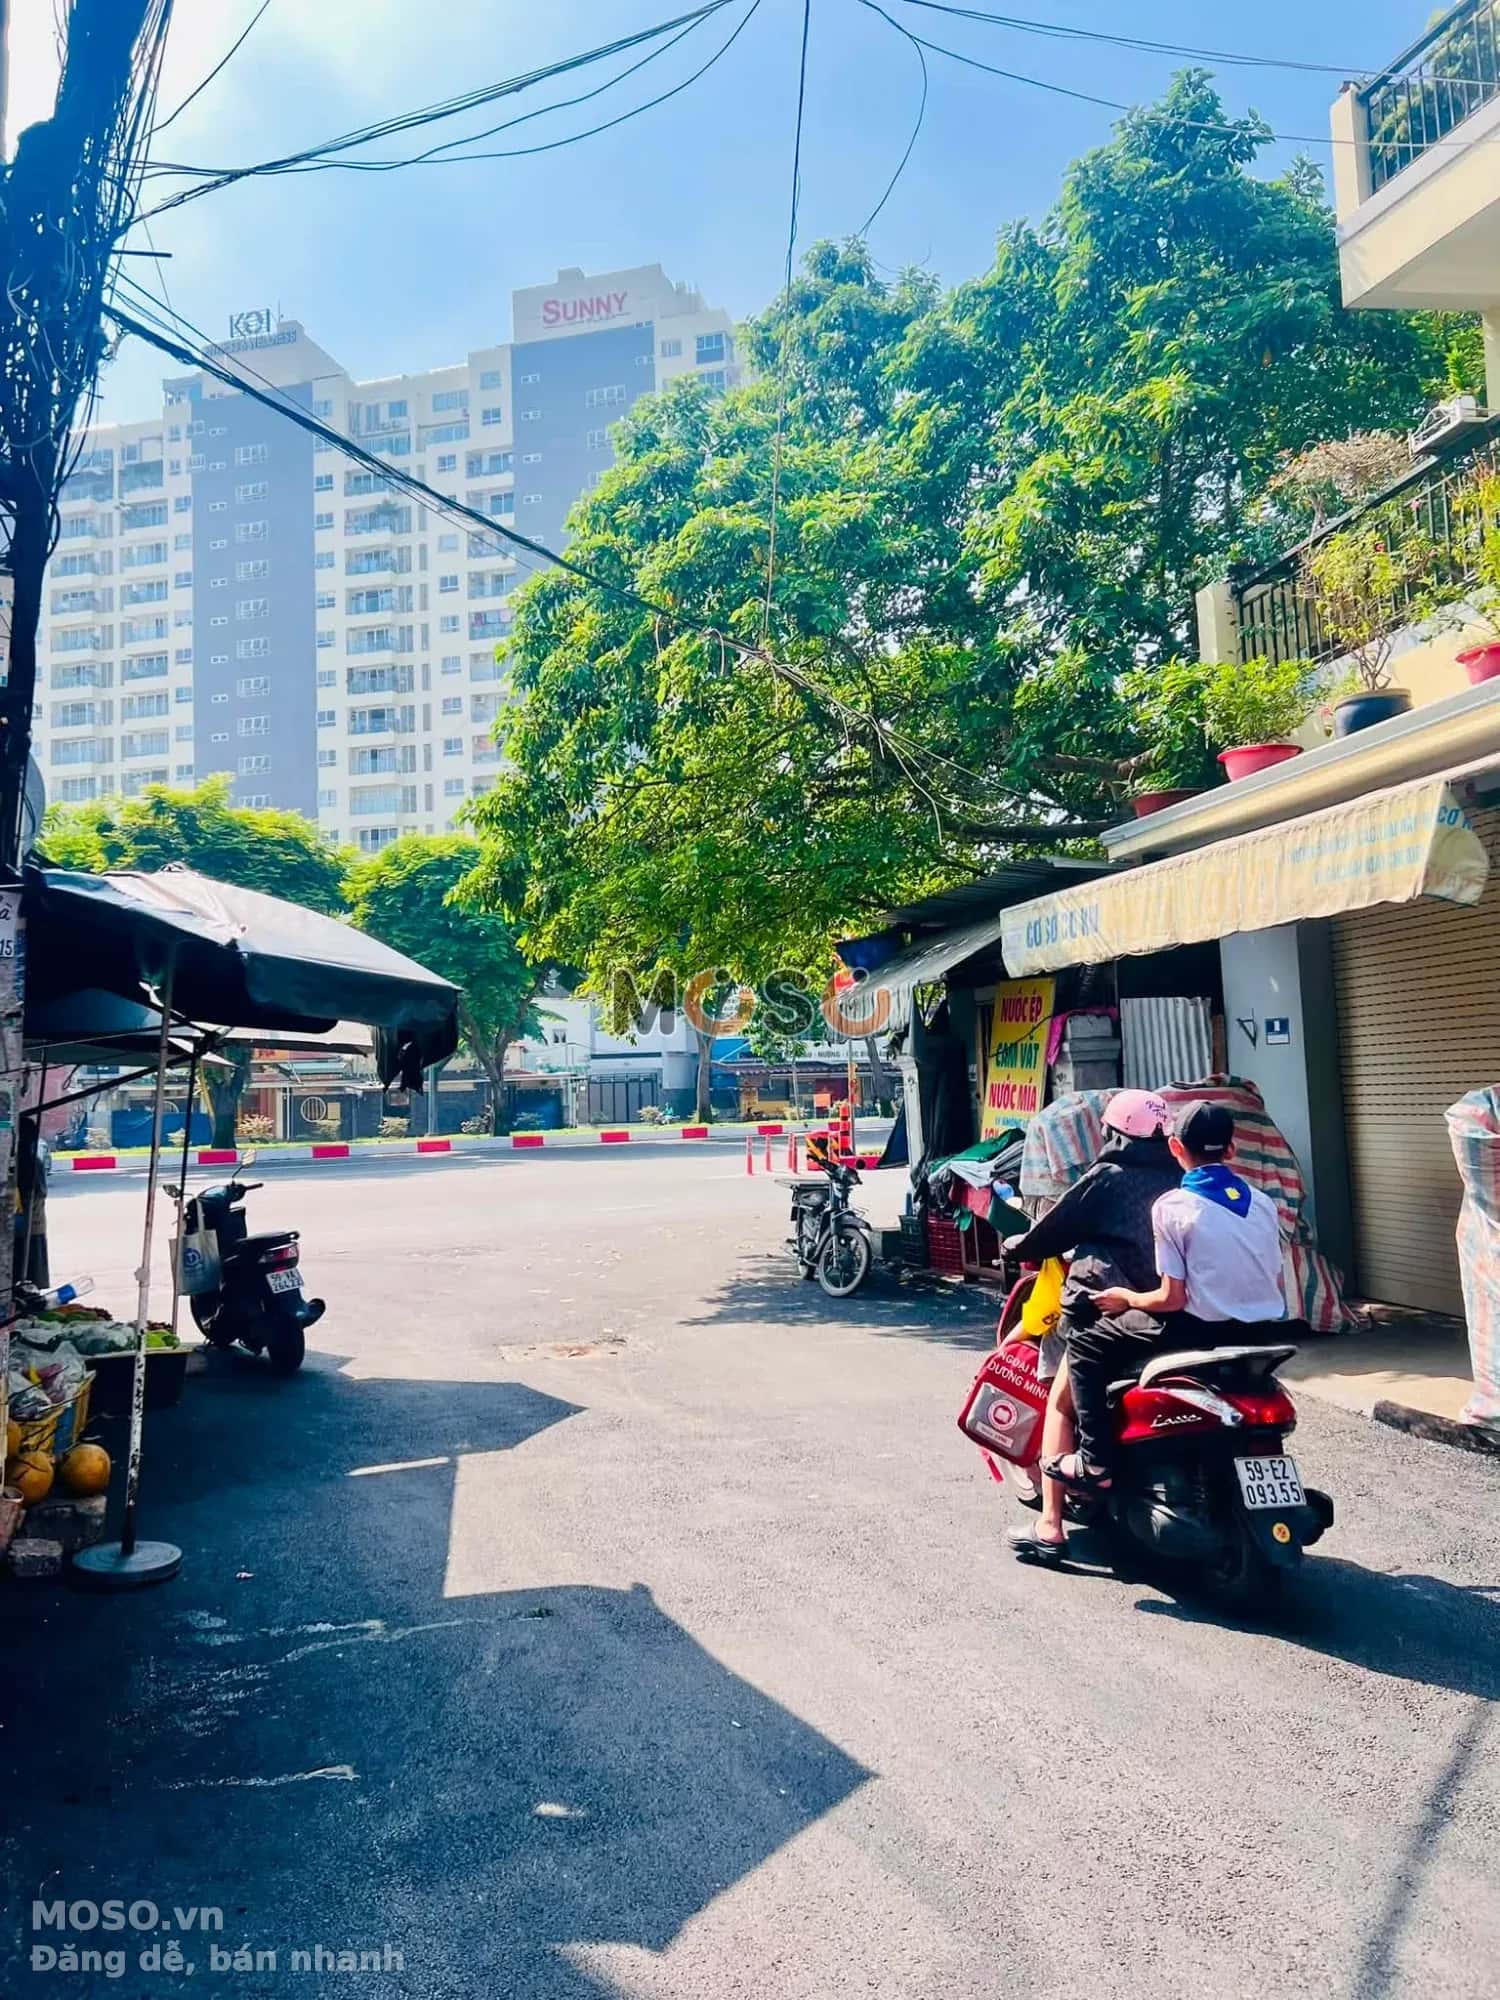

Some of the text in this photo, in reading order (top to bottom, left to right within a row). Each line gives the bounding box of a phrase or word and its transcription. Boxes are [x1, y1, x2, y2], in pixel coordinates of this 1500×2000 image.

[543, 291, 628, 325] SUNNY
[988, 1073, 1037, 1113] NƯỚC MÍA
[1244, 1460, 1290, 1482] 59-E2
[1245, 1482, 1301, 1505] 093.55
